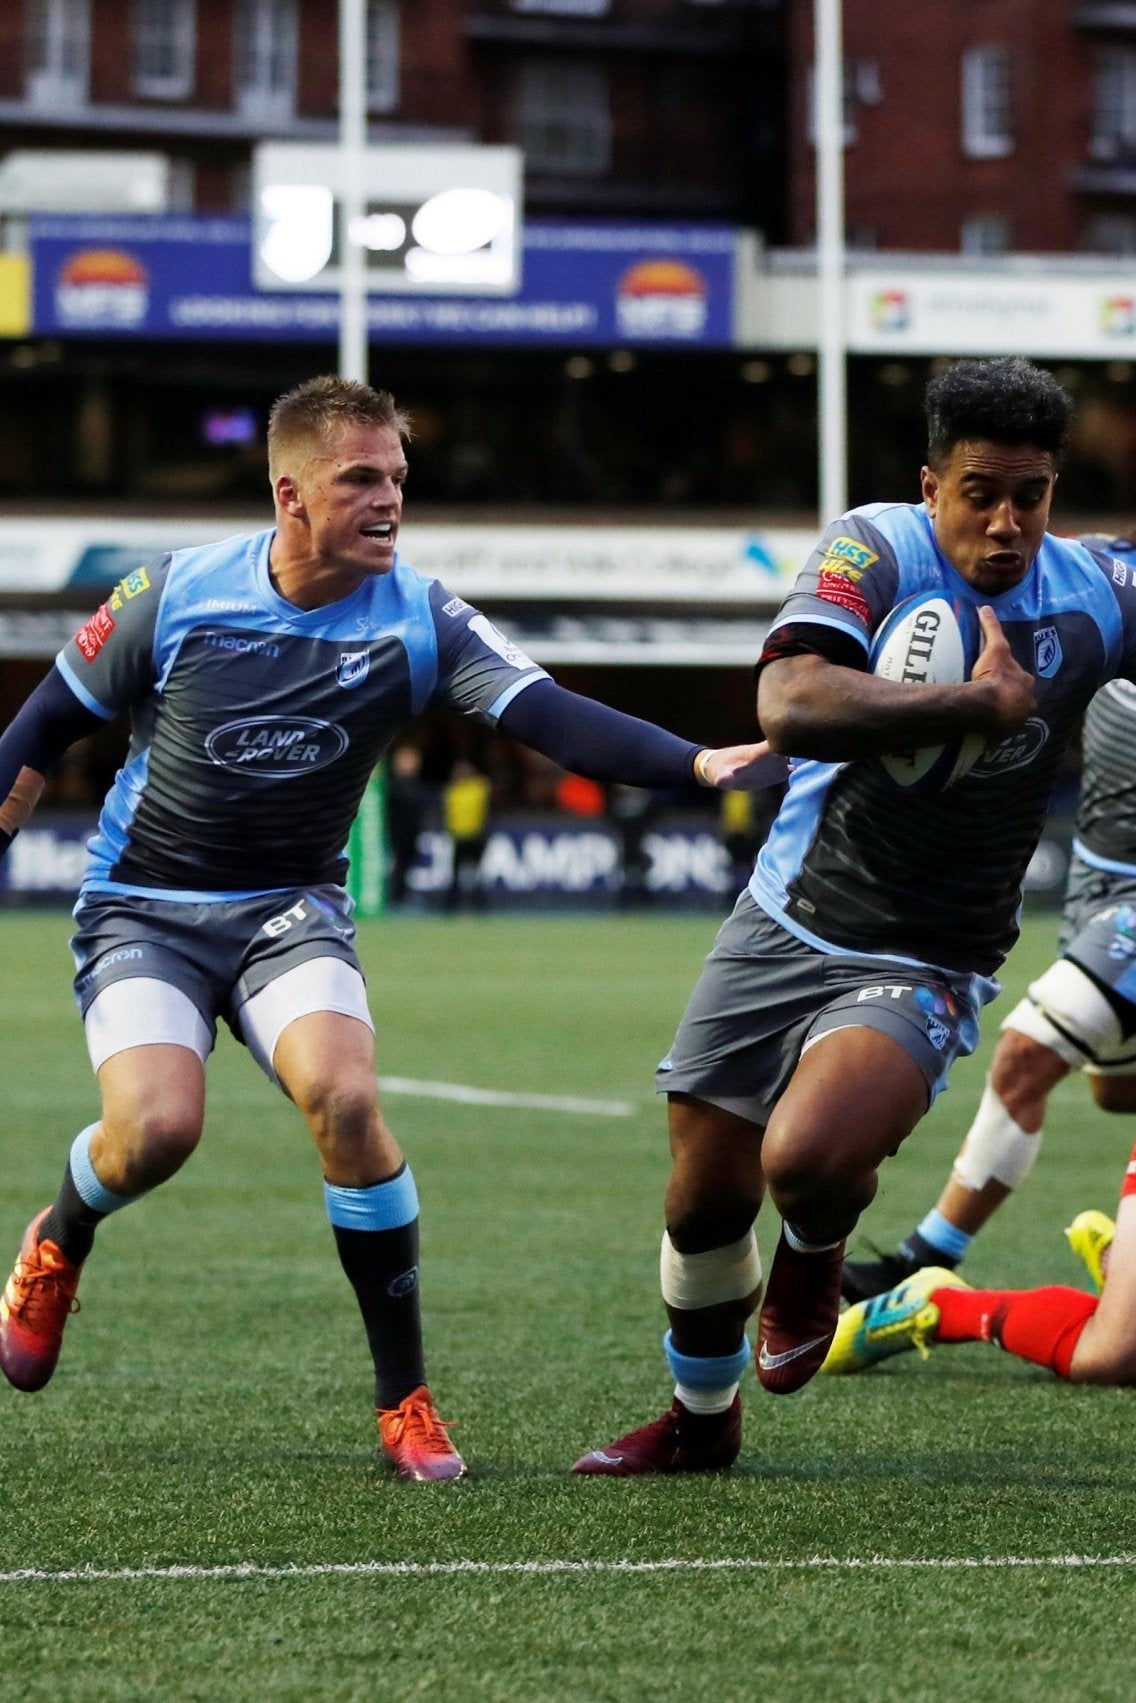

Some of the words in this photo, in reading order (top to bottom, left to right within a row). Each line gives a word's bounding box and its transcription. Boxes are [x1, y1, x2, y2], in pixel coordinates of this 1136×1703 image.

[202, 631, 280, 658] macron
[236, 730, 305, 747] LAND
[236, 744, 321, 763] ROVER
[262, 899, 307, 938] BT
[857, 985, 913, 1003] BT
